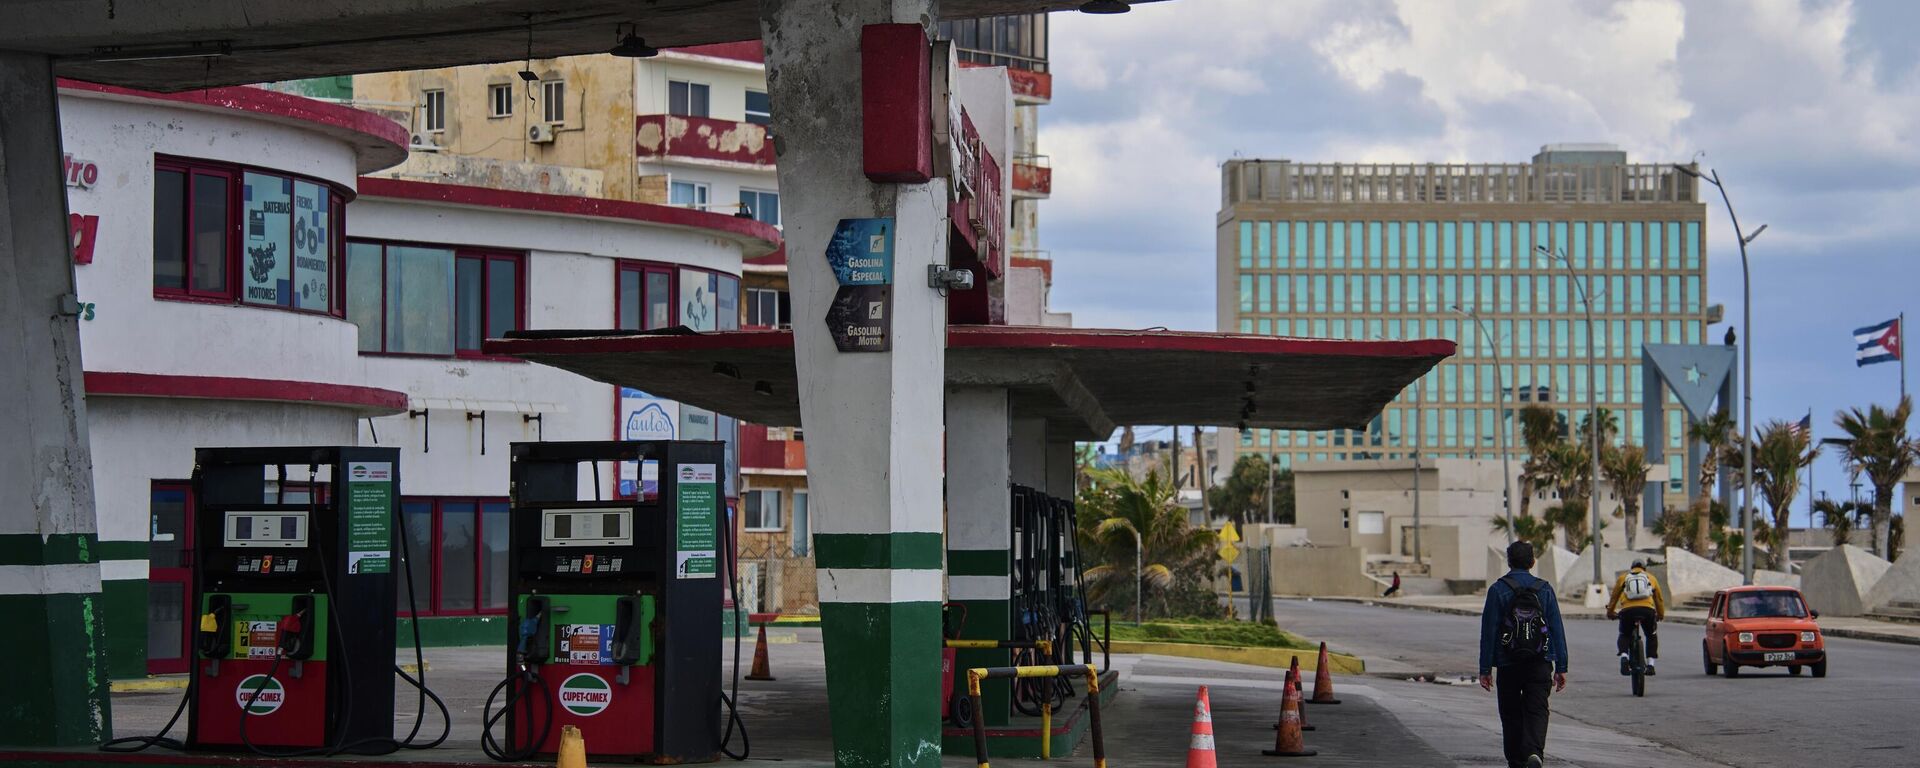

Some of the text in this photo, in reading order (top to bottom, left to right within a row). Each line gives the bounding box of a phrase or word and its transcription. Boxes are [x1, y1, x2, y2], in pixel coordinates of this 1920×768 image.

[263, 201, 290, 214] BATERIAS
[848, 257, 884, 268] GASOLINA
[852, 270, 884, 281] ESPECIAL
[248, 286, 276, 300] MOTORES
[847, 325, 882, 337] GASOLINA
[858, 336, 882, 346] MOTOR
[240, 621, 249, 634] 23
[561, 625, 571, 638] 19
[606, 625, 616, 638] 17
[240, 692, 281, 702] CUP-CIMEX
[562, 691, 608, 702] CUPET-CIMEX
